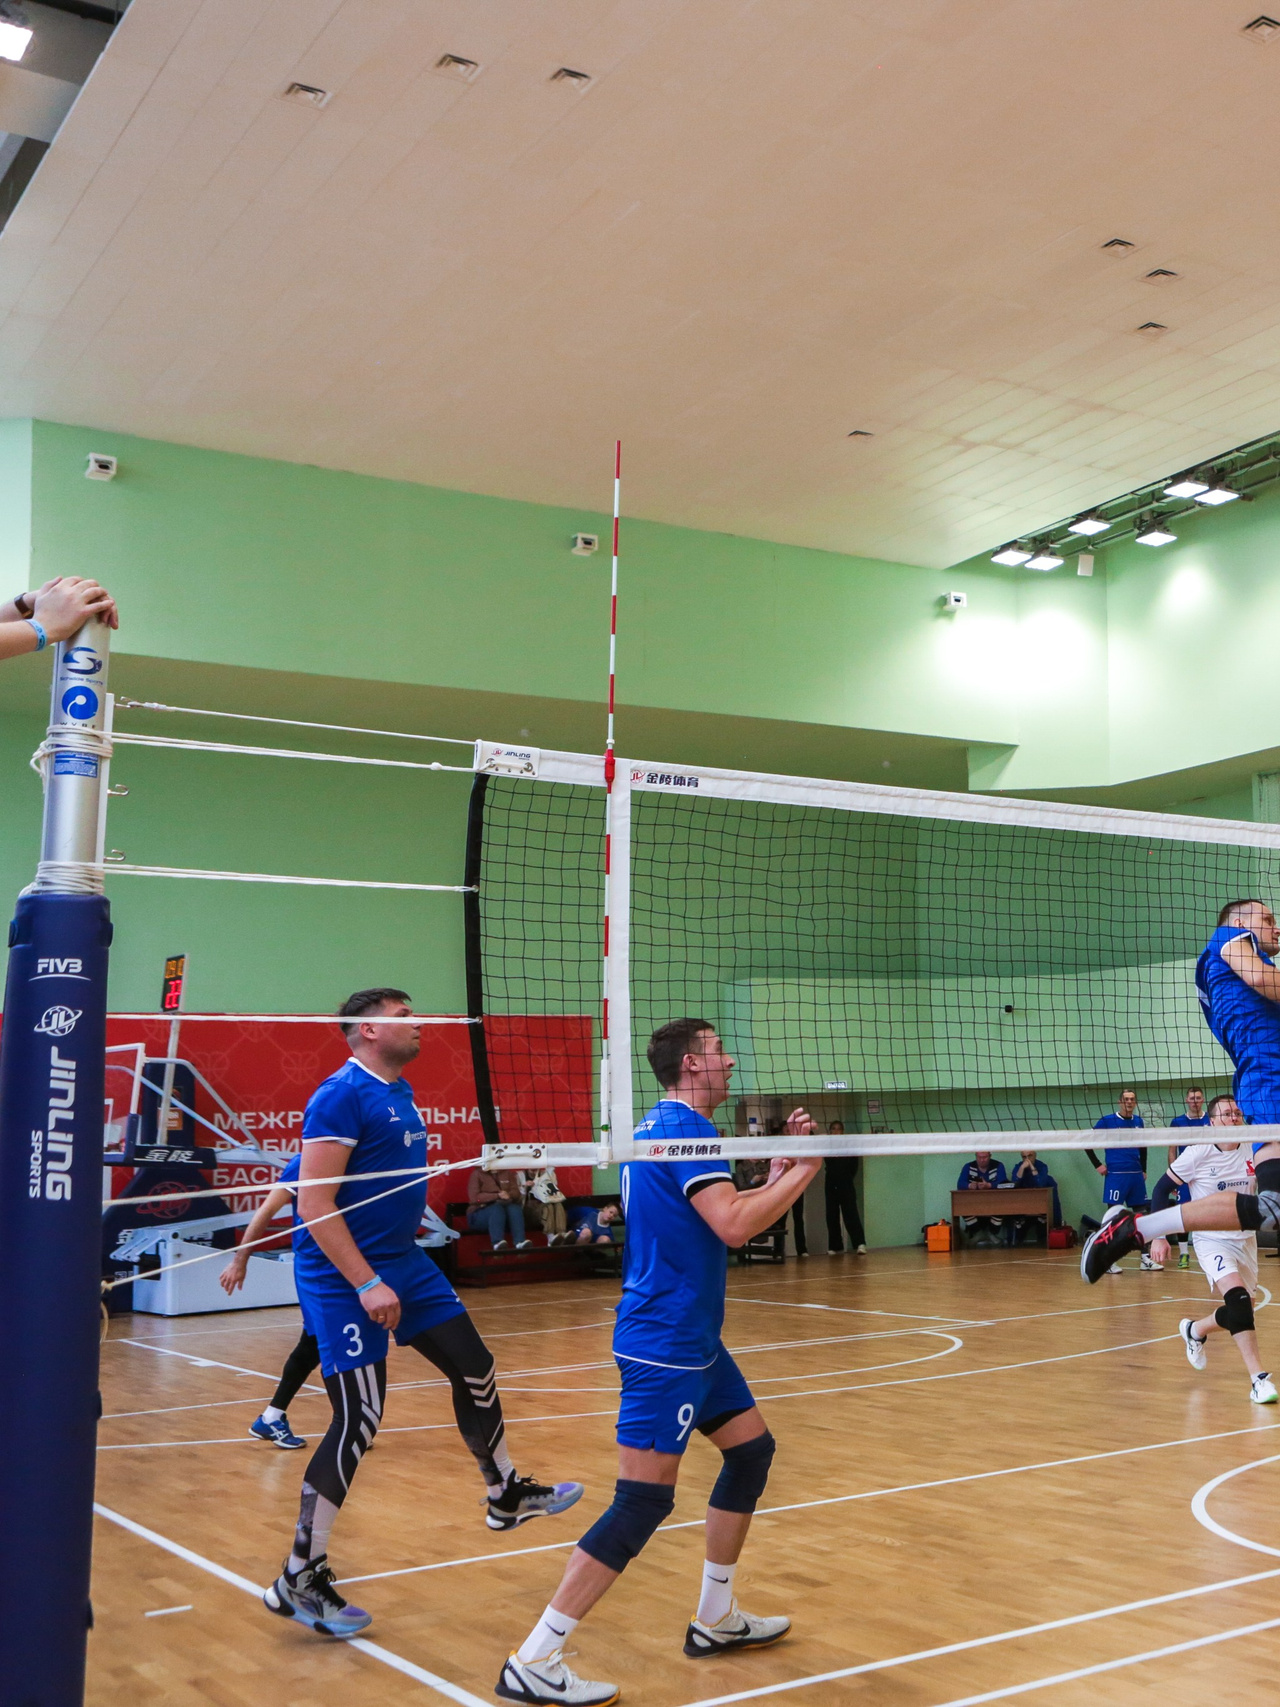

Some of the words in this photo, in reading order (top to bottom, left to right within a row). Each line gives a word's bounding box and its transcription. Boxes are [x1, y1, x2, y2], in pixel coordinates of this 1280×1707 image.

[646, 772, 699, 788] 金陵体育
[46, 1045, 76, 1201] JINLING
[145, 1149, 195, 1162] 金陵
[667, 1144, 722, 1156] 金陵体育
[29, 1130, 43, 1199] SPORTS
[1109, 1189, 1120, 1202] 10
[1214, 1255, 1226, 1271] 2
[342, 1323, 363, 1357] 3
[676, 1403, 694, 1442] 9
